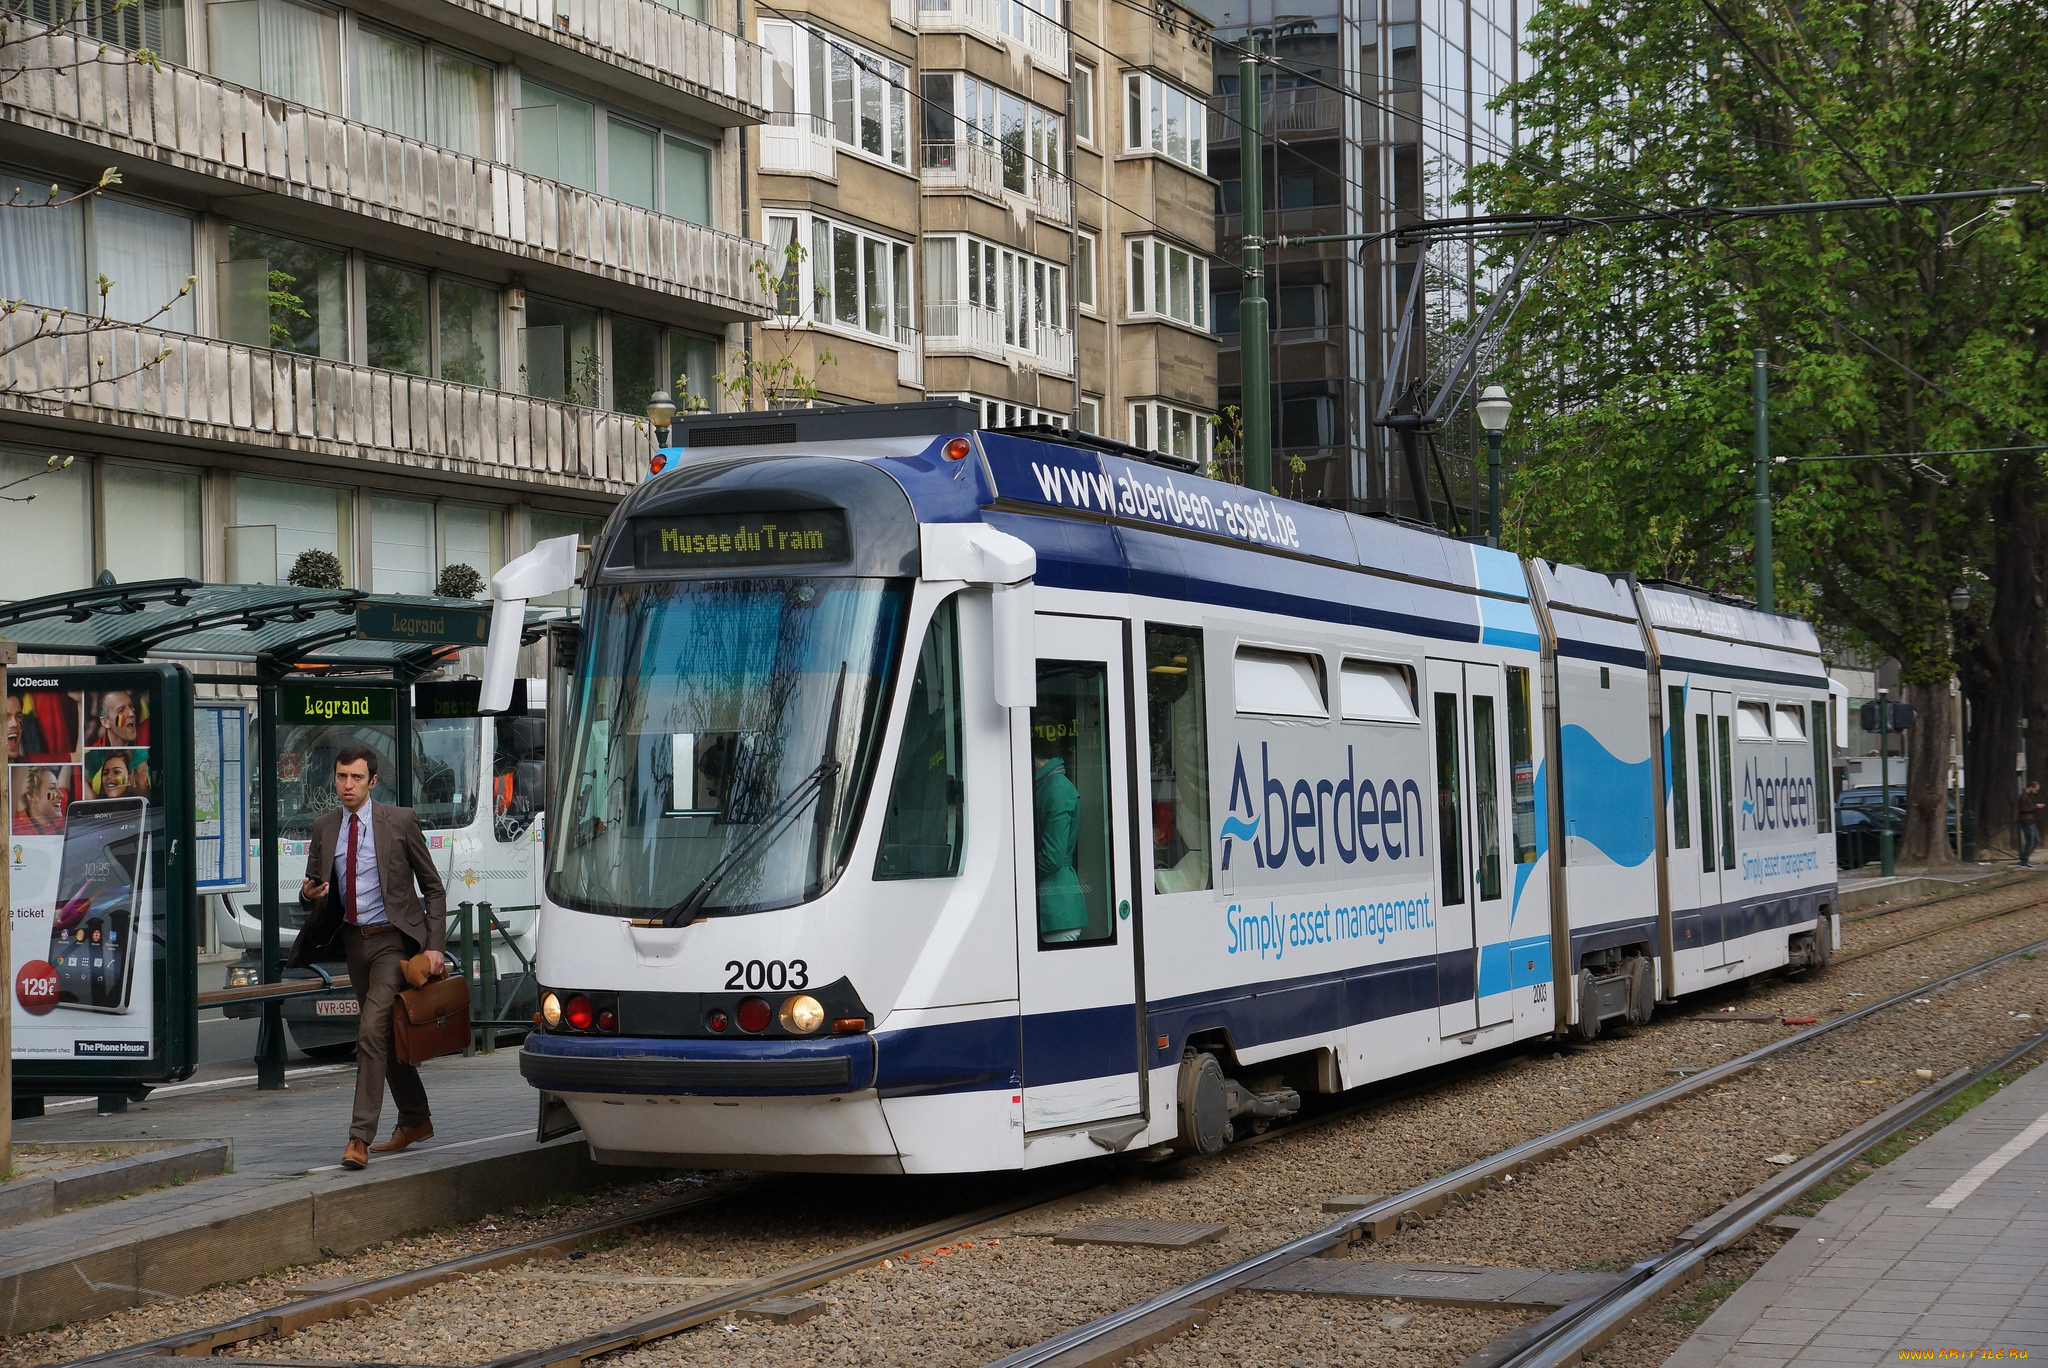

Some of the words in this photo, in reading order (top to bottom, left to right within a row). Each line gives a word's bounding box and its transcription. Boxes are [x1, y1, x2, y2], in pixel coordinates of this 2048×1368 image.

[1032, 462, 1300, 548] www.aberdeen-asset.be
[661, 528, 731, 553] Musee
[735, 525, 761, 551] du
[762, 524, 823, 550] Tram
[392, 613, 445, 637] Legrand
[12, 677, 59, 687] JCDecaux
[304, 696, 370, 718] Legrand
[1220, 741, 1424, 869] Aberdeen
[1741, 756, 1816, 832] Aberdeen
[84, 863, 110, 877] 10:35
[1742, 850, 1764, 885] Simply
[1764, 852, 1781, 877] asset
[17, 908, 45, 918] ticket
[1227, 901, 1286, 960] Simply
[1289, 903, 1332, 947] asset
[1335, 892, 1434, 945] management.
[22, 978, 47, 996] 129
[724, 959, 809, 991] 2003
[1533, 984, 1547, 1004] 2003
[79, 1043, 94, 1051] The
[95, 1043, 120, 1051] Phone
[120, 1043, 145, 1052] House
